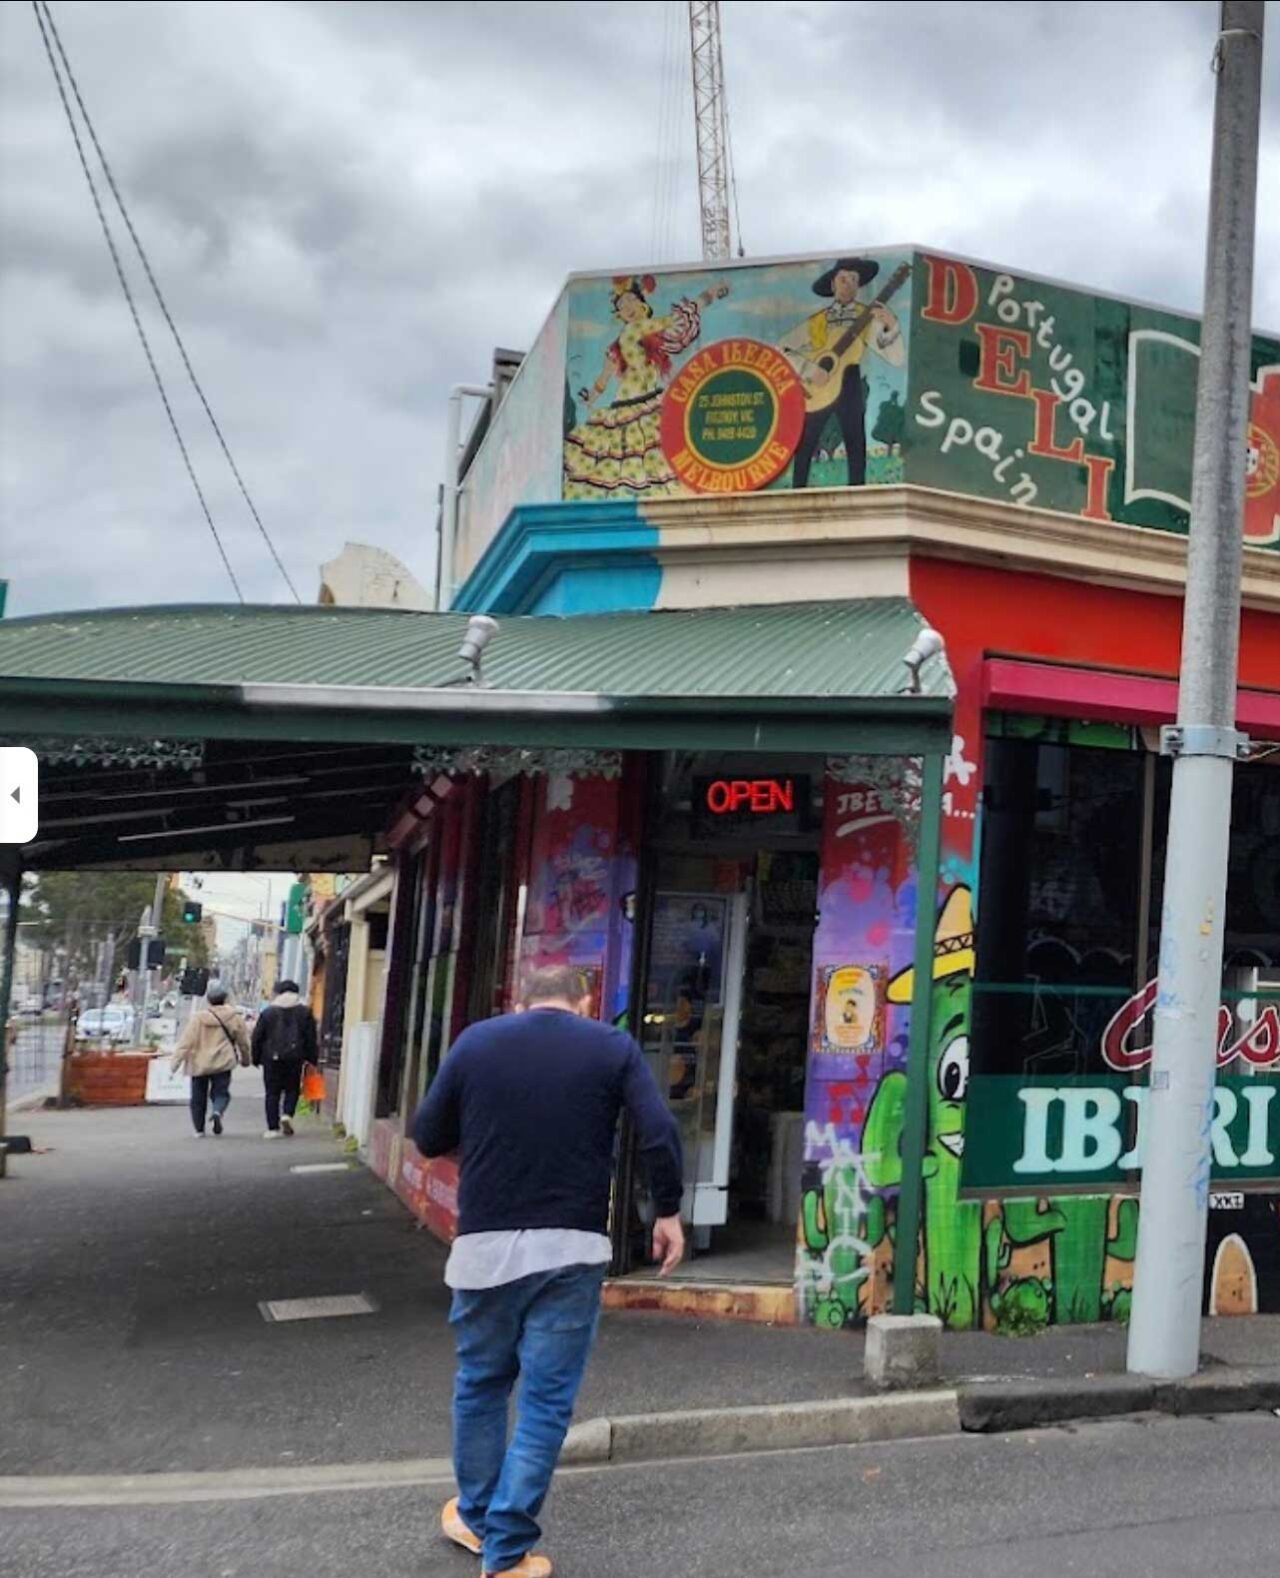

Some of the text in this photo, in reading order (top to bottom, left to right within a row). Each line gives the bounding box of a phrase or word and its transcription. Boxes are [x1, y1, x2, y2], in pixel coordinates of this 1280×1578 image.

[669, 342, 796, 403] CASA IBERICA
[921, 255, 1115, 521] DELI
[988, 274, 1114, 440] Portugal
[671, 441, 790, 492] MELBOURNE
[914, 391, 1038, 506] Spain
[707, 780, 794, 813] OPEN
